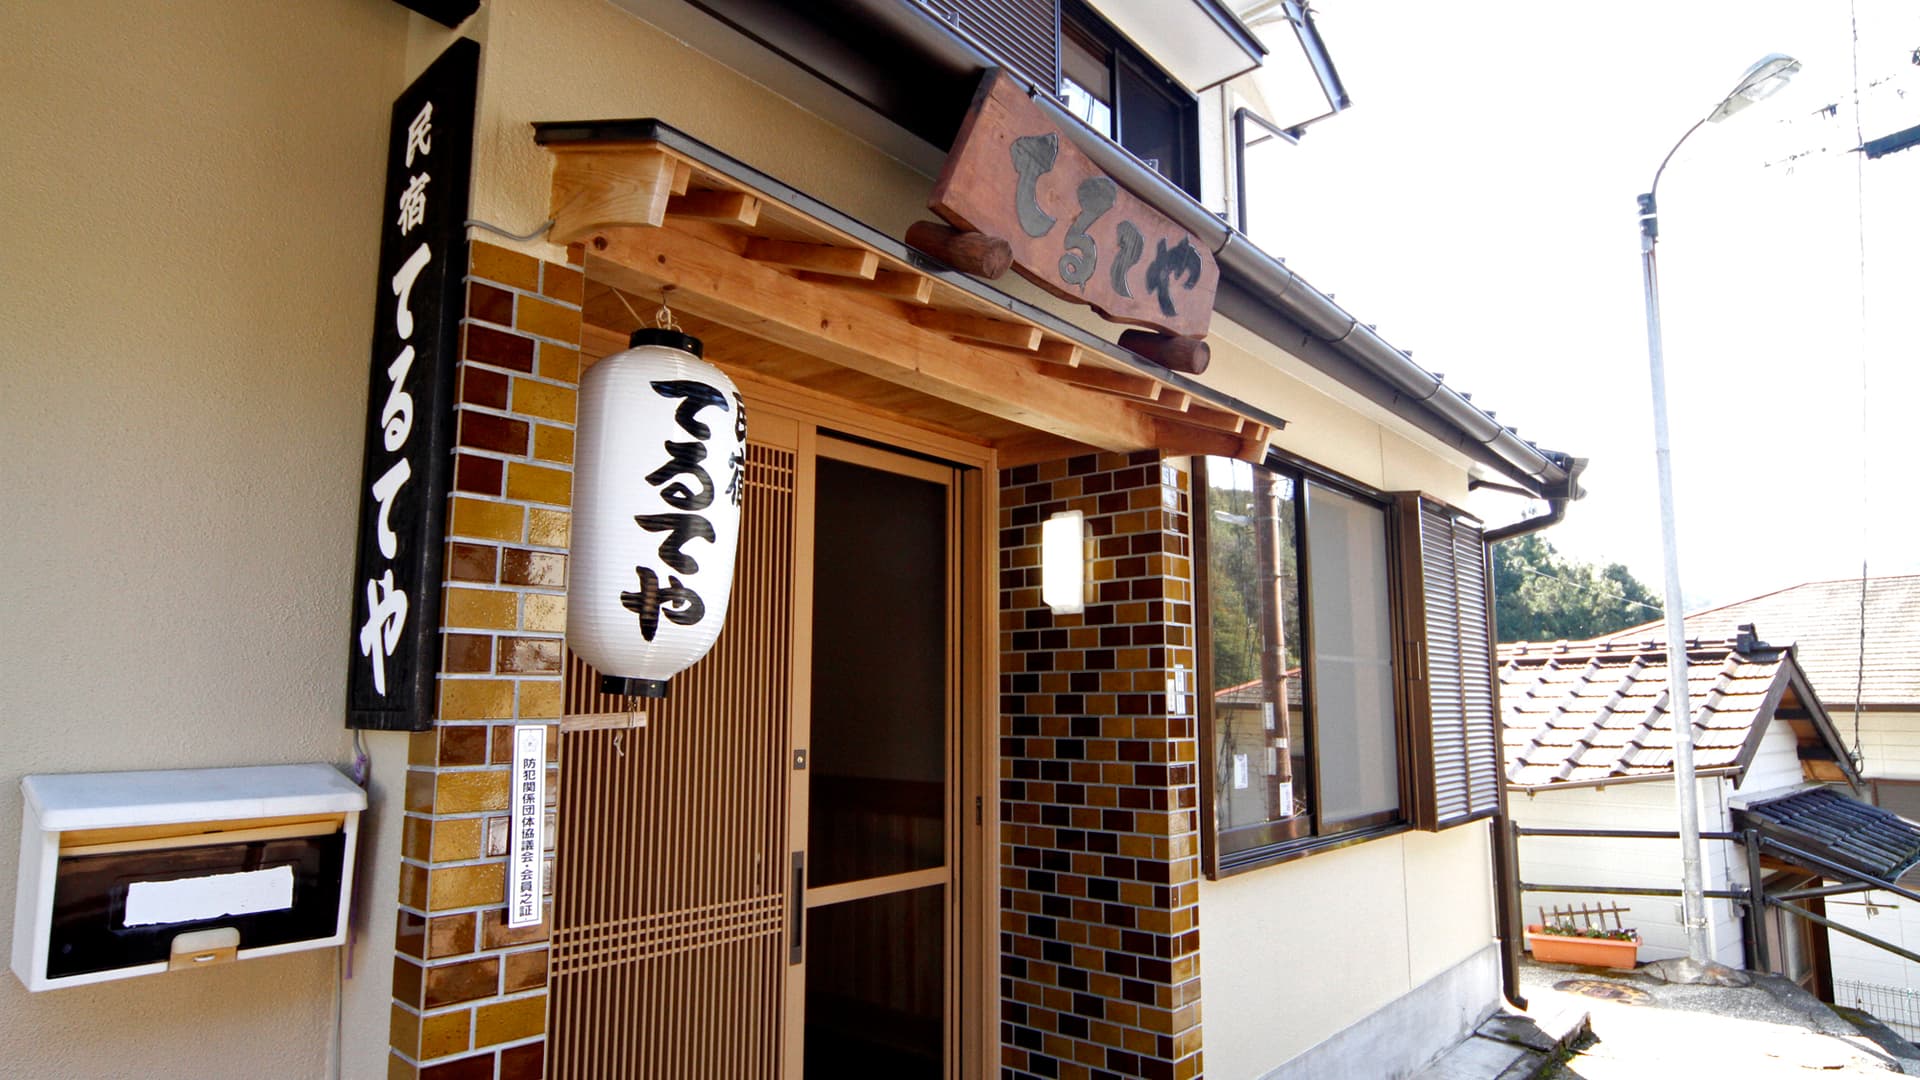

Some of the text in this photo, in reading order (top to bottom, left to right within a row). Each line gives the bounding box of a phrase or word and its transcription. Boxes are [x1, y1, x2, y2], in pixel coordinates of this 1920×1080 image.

[620, 380, 729, 642] てるてや
[519, 758, 536, 918] 防犯関係団体協議会・会員之証
